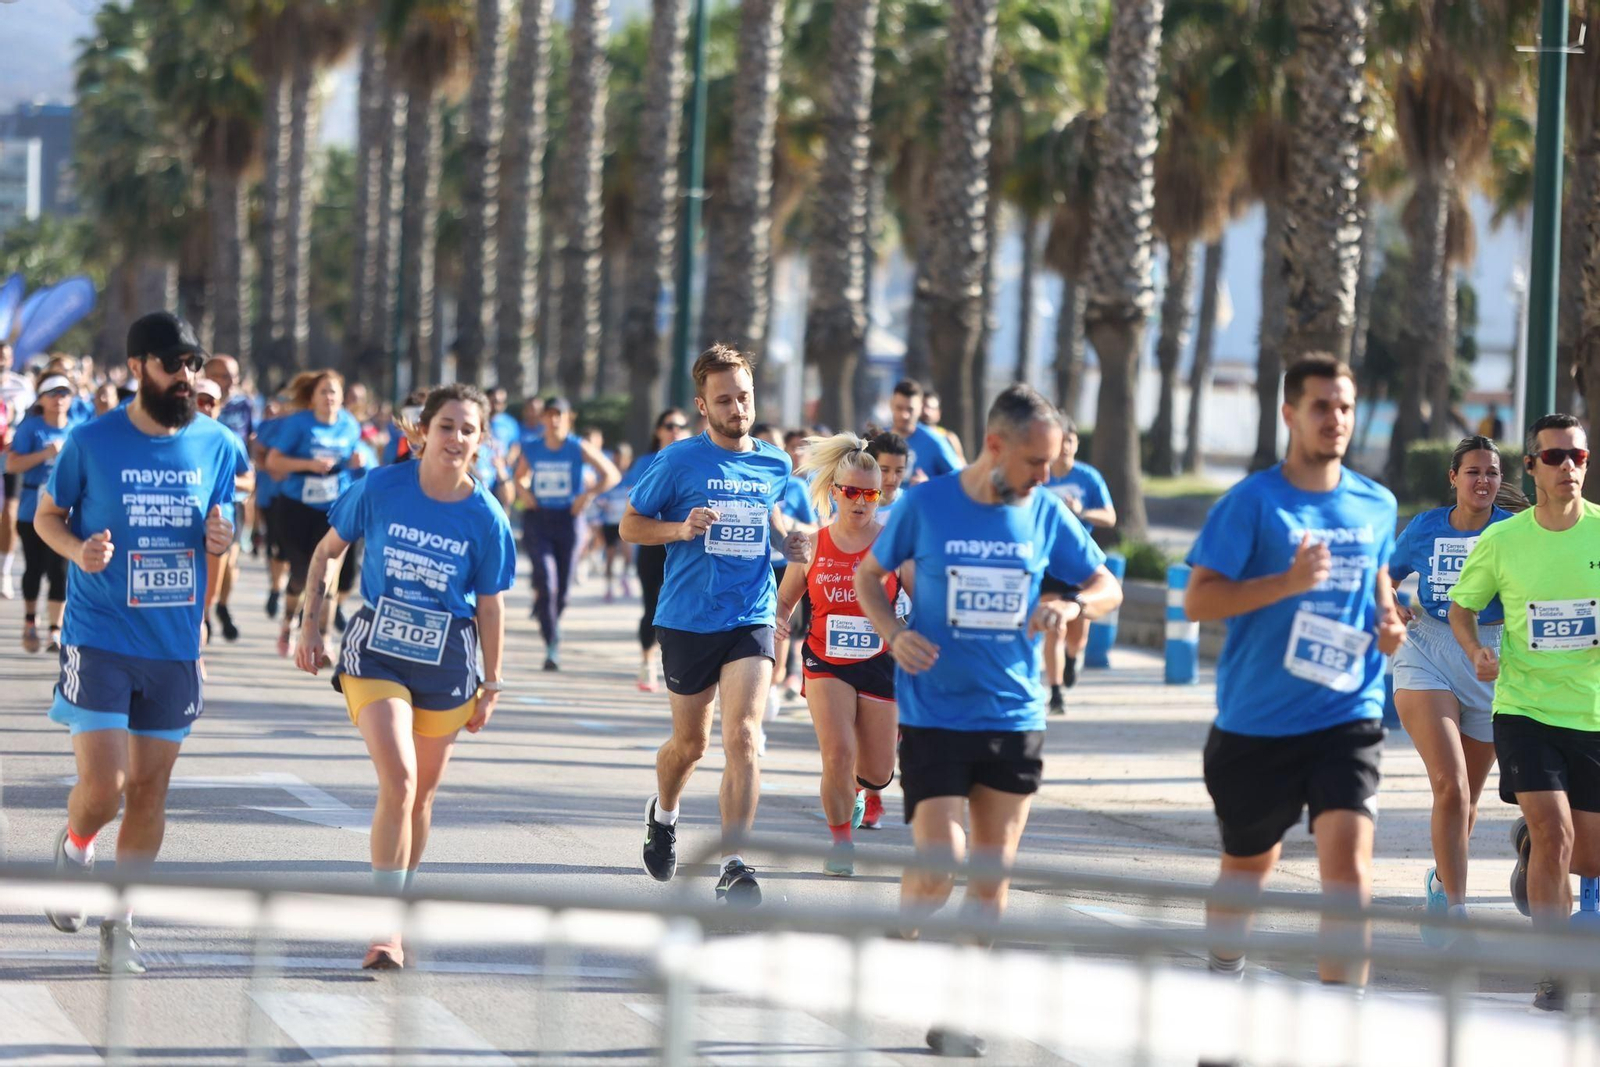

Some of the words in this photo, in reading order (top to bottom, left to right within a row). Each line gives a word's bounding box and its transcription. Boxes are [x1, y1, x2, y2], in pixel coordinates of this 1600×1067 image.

[121, 467, 202, 487] mayoral
[708, 478, 771, 494] mayoral
[128, 515, 192, 527] FRIENDS
[387, 523, 469, 557] mayoral
[720, 526, 756, 541] 922
[944, 539, 1034, 559] mayoral
[1442, 556, 1467, 571] 10
[139, 571, 189, 587] 1896
[386, 567, 448, 593] FRIENDS
[823, 585, 856, 603] Véle
[960, 592, 1019, 612] 1045
[381, 620, 438, 646] 2102
[1543, 619, 1584, 636] 267
[837, 633, 871, 647] 219
[1308, 643, 1348, 671] 182
